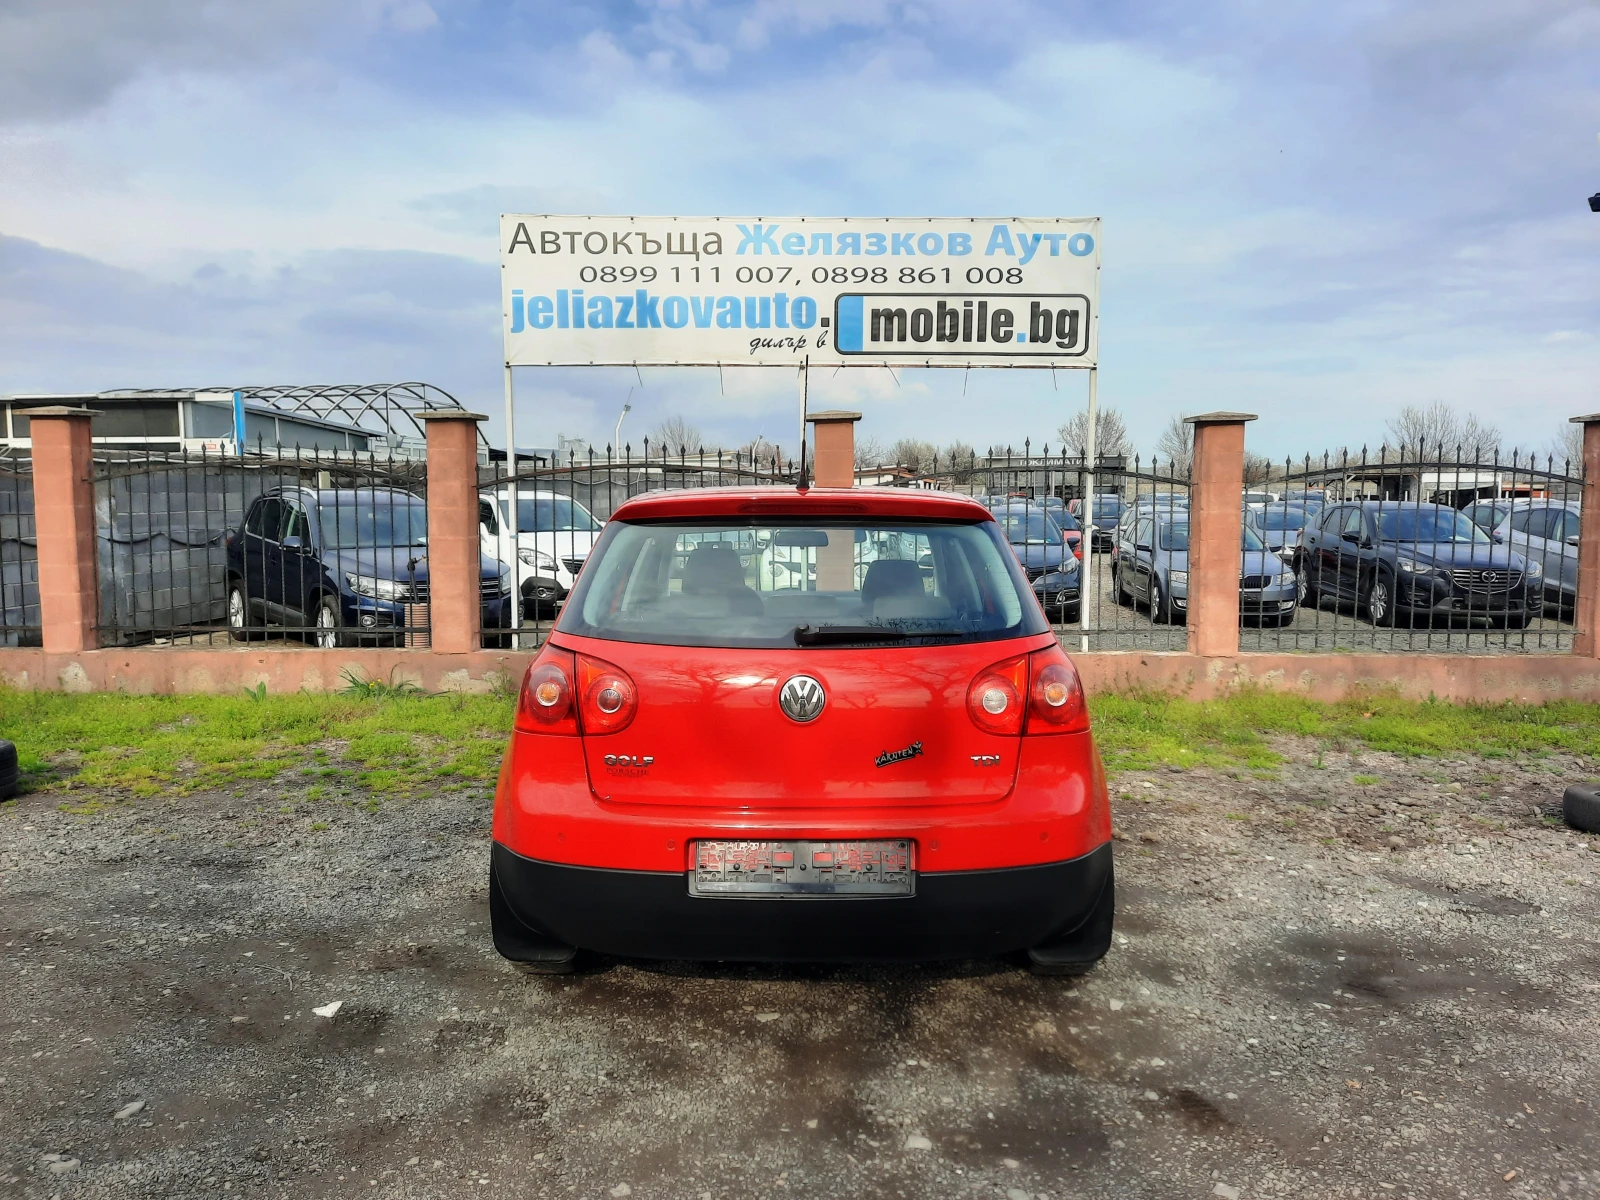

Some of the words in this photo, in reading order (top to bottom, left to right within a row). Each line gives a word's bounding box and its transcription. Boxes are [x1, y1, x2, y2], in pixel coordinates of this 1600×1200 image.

[508, 222, 722, 261] Автокъща
[735, 223, 973, 256] Желязков
[984, 224, 1095, 266] Ауто
[579, 266, 658, 283] 0899
[670, 266, 721, 283] 111
[735, 266, 800, 286] 007,
[811, 266, 888, 284] 0898
[898, 266, 950, 284] 861
[965, 267, 1024, 284] 008
[870, 300, 1079, 349] mobile.bg
[604, 754, 655, 768] GOLF
[970, 755, 1000, 767] TDI
